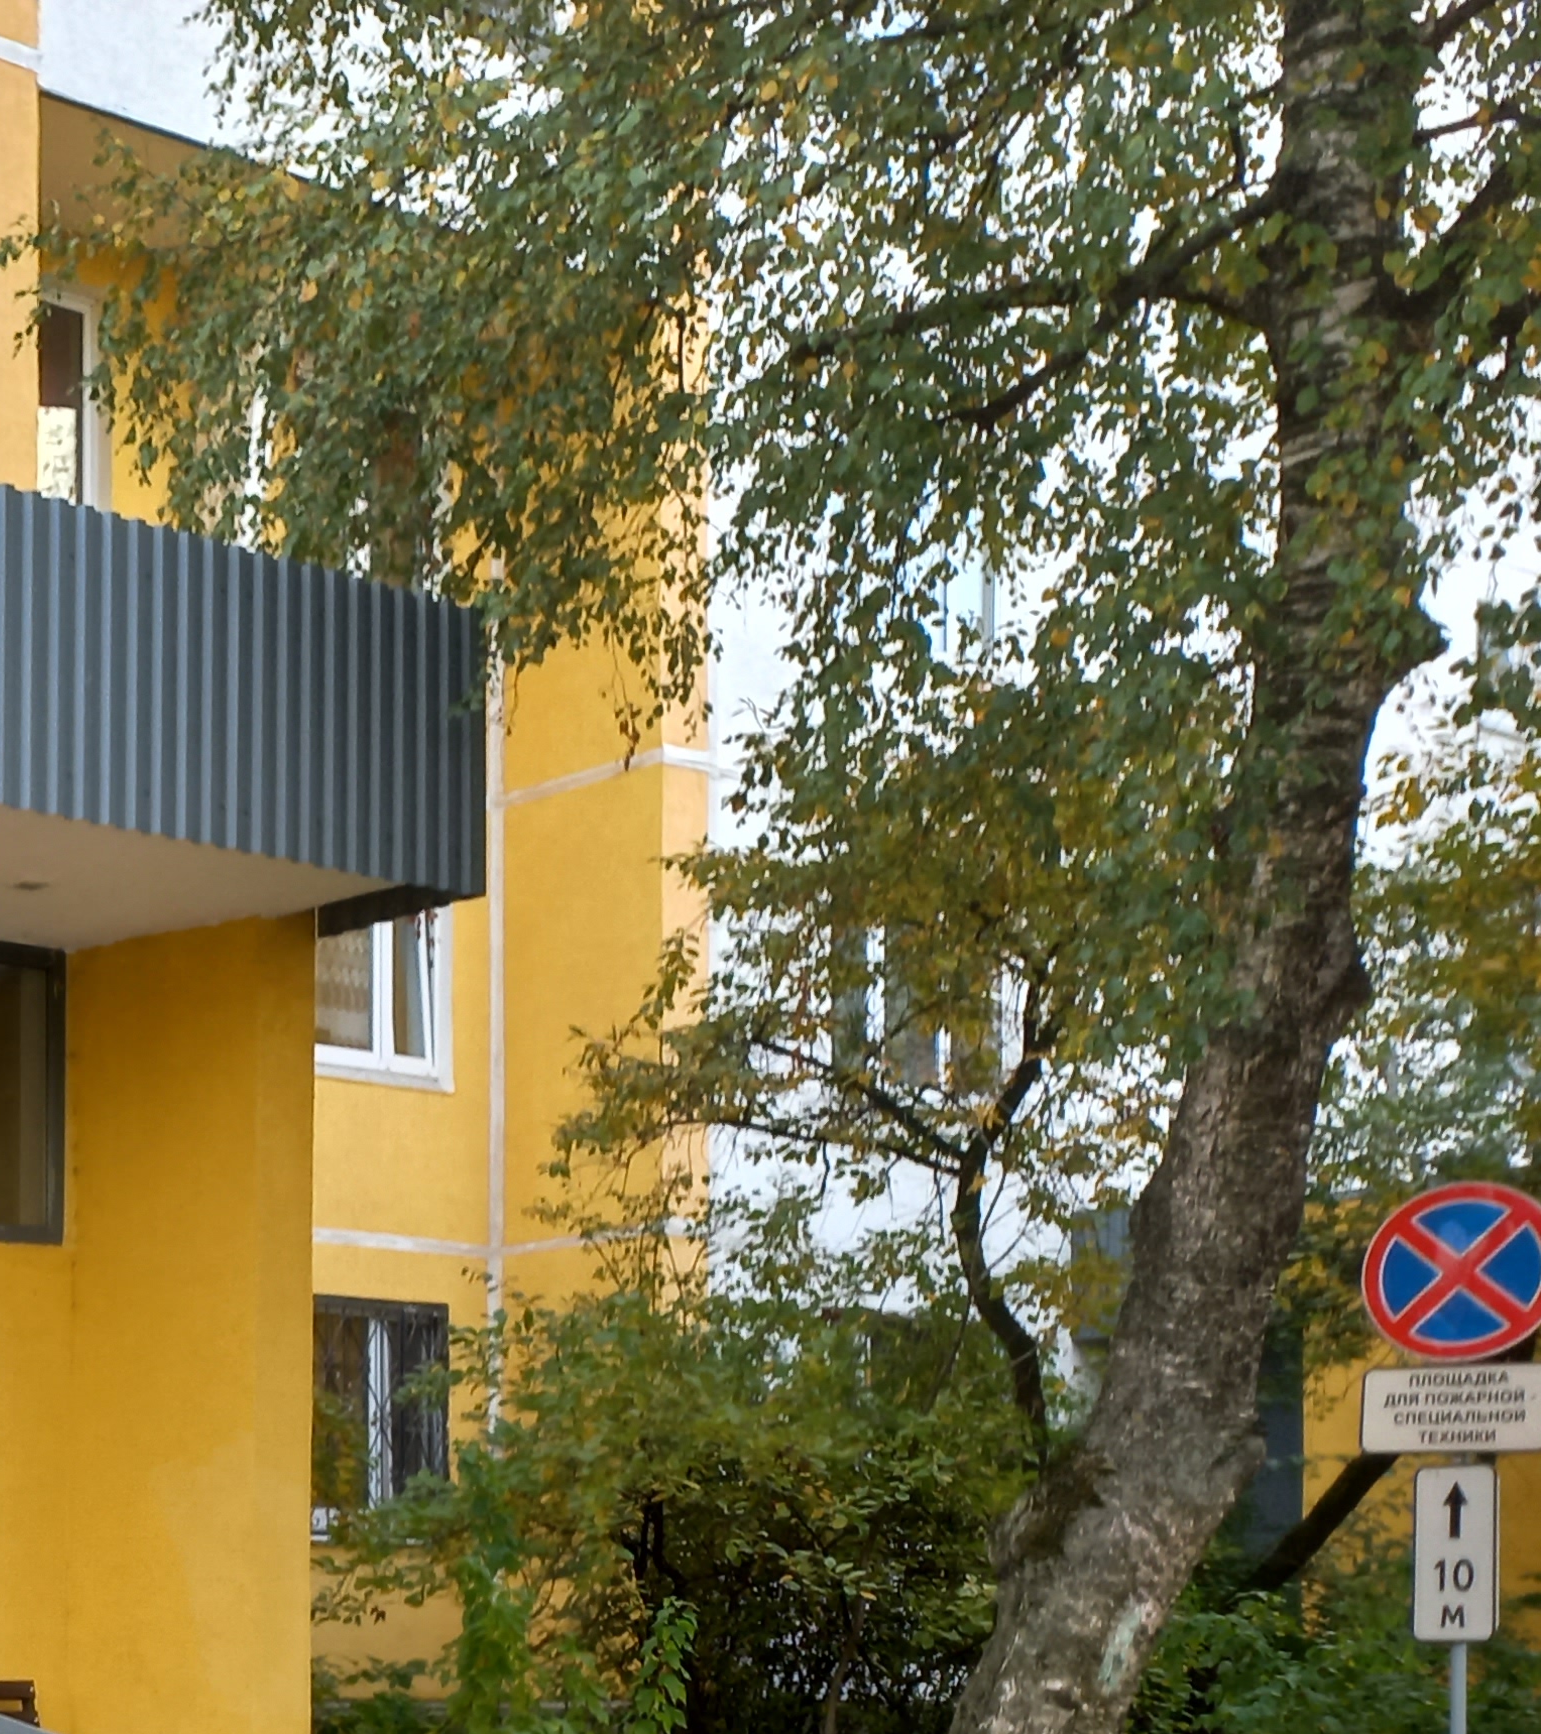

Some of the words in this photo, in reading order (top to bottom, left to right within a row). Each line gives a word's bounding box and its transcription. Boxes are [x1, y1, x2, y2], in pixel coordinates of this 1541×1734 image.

[1408, 1370, 1509, 1388] ПЛОЩАДКА
[1383, 1392, 1419, 1409] ДЛЯ
[1424, 1386, 1526, 1406] ПОЖАРНОЙ
[1393, 1408, 1526, 1426] СПЕЦИАЛЬНОЙ
[1419, 1429, 1497, 1445] ТЕХНИКИ
[1433, 1558, 1475, 1593] 10
[1440, 1604, 1465, 1628] М
